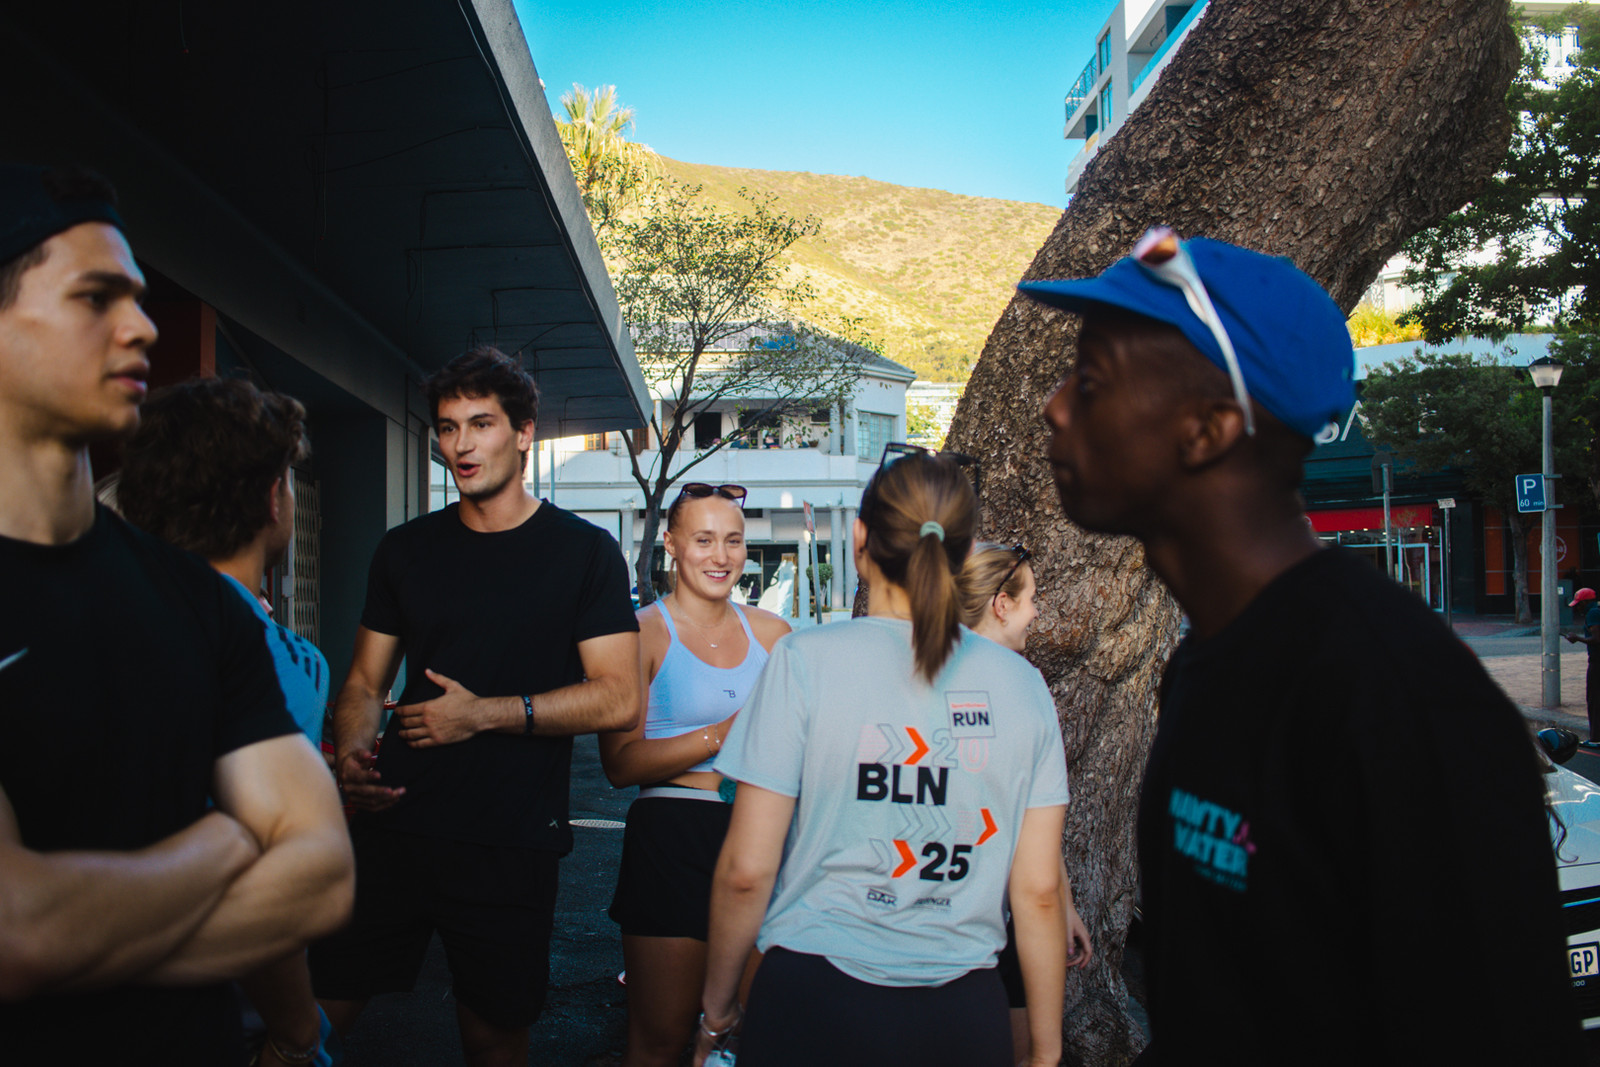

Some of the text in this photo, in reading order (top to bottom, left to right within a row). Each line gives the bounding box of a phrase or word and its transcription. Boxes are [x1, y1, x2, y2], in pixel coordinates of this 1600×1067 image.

[1523, 479, 1536, 495] P
[1520, 499, 1530, 507] 60
[952, 711, 991, 727] RUN
[857, 763, 949, 805] BLN
[919, 842, 973, 881] 25
[1570, 950, 1594, 974] GP
